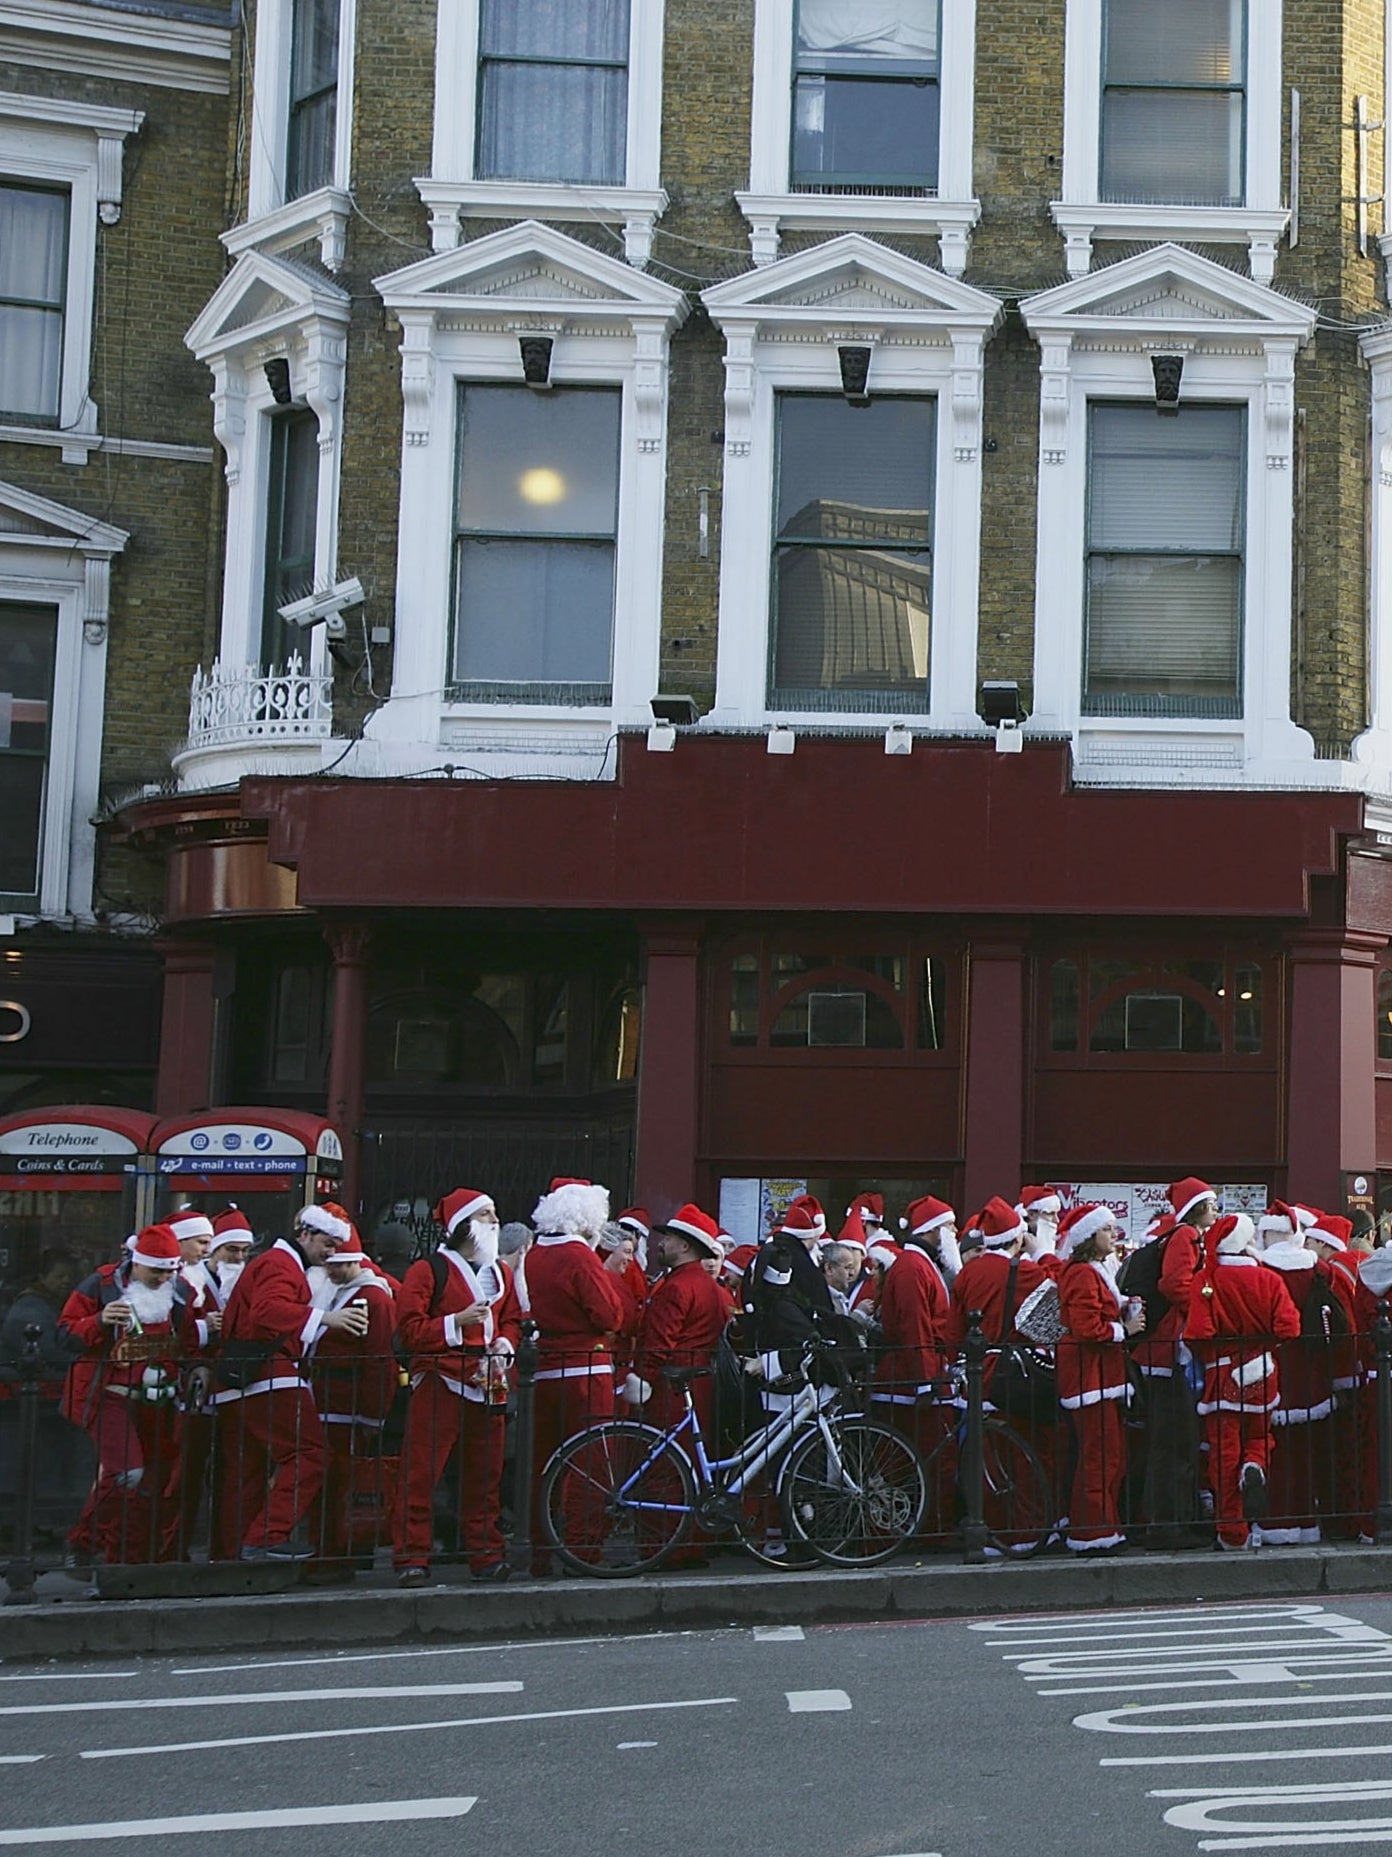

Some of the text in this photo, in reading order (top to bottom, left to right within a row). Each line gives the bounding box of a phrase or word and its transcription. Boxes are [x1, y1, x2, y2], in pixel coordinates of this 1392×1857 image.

[28, 1133, 98, 1148] Telephone
[17, 1158, 104, 1171] Coins & Cards
[191, 1160, 297, 1171] e-mail text phone
